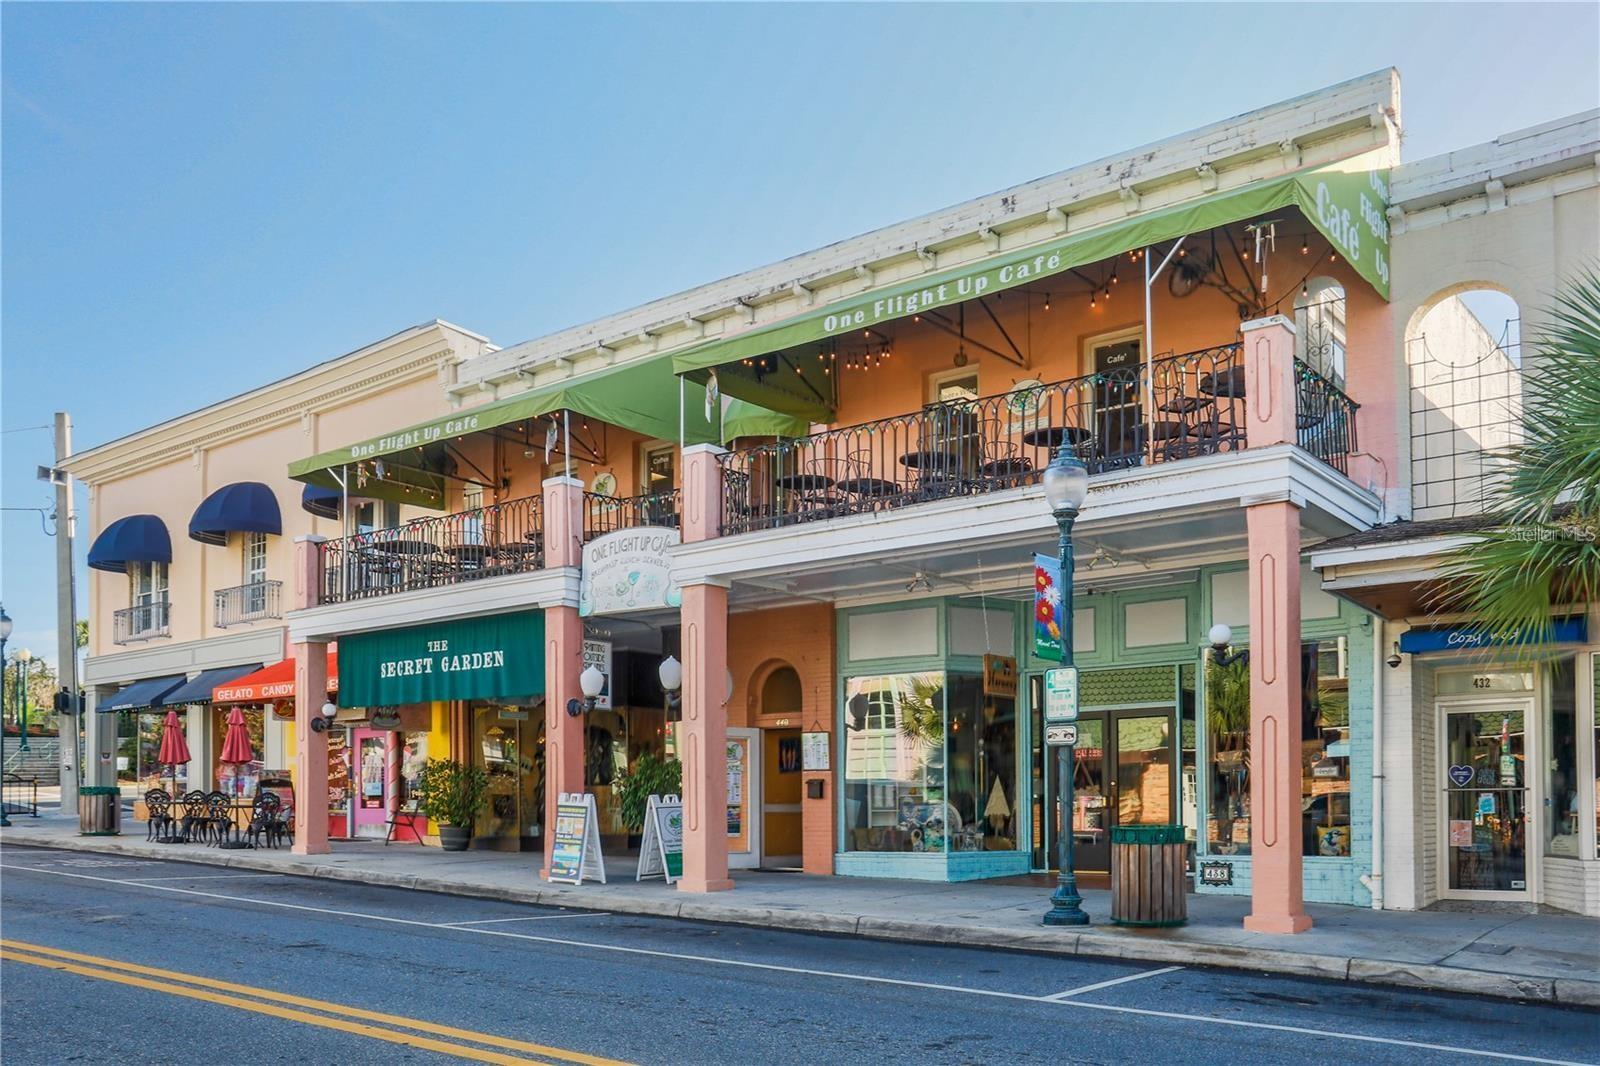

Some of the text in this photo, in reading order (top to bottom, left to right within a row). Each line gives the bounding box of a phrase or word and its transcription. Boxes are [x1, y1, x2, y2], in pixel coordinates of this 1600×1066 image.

[1316, 181, 1360, 261] Café
[1375, 248, 1389, 285] Up
[823, 250, 1060, 332] One Flight Up Café
[351, 414, 480, 457] One Flight Up Café
[591, 543, 609, 563] ONE
[609, 536, 640, 556] FLIGHT
[640, 535, 651, 552] UP
[427, 640, 449, 653] THE
[1447, 632, 1483, 646] Cozy
[380, 650, 504, 679] SECRET GARDEN
[217, 683, 294, 700] GELATO CANDY
[1472, 677, 1491, 689] 432
